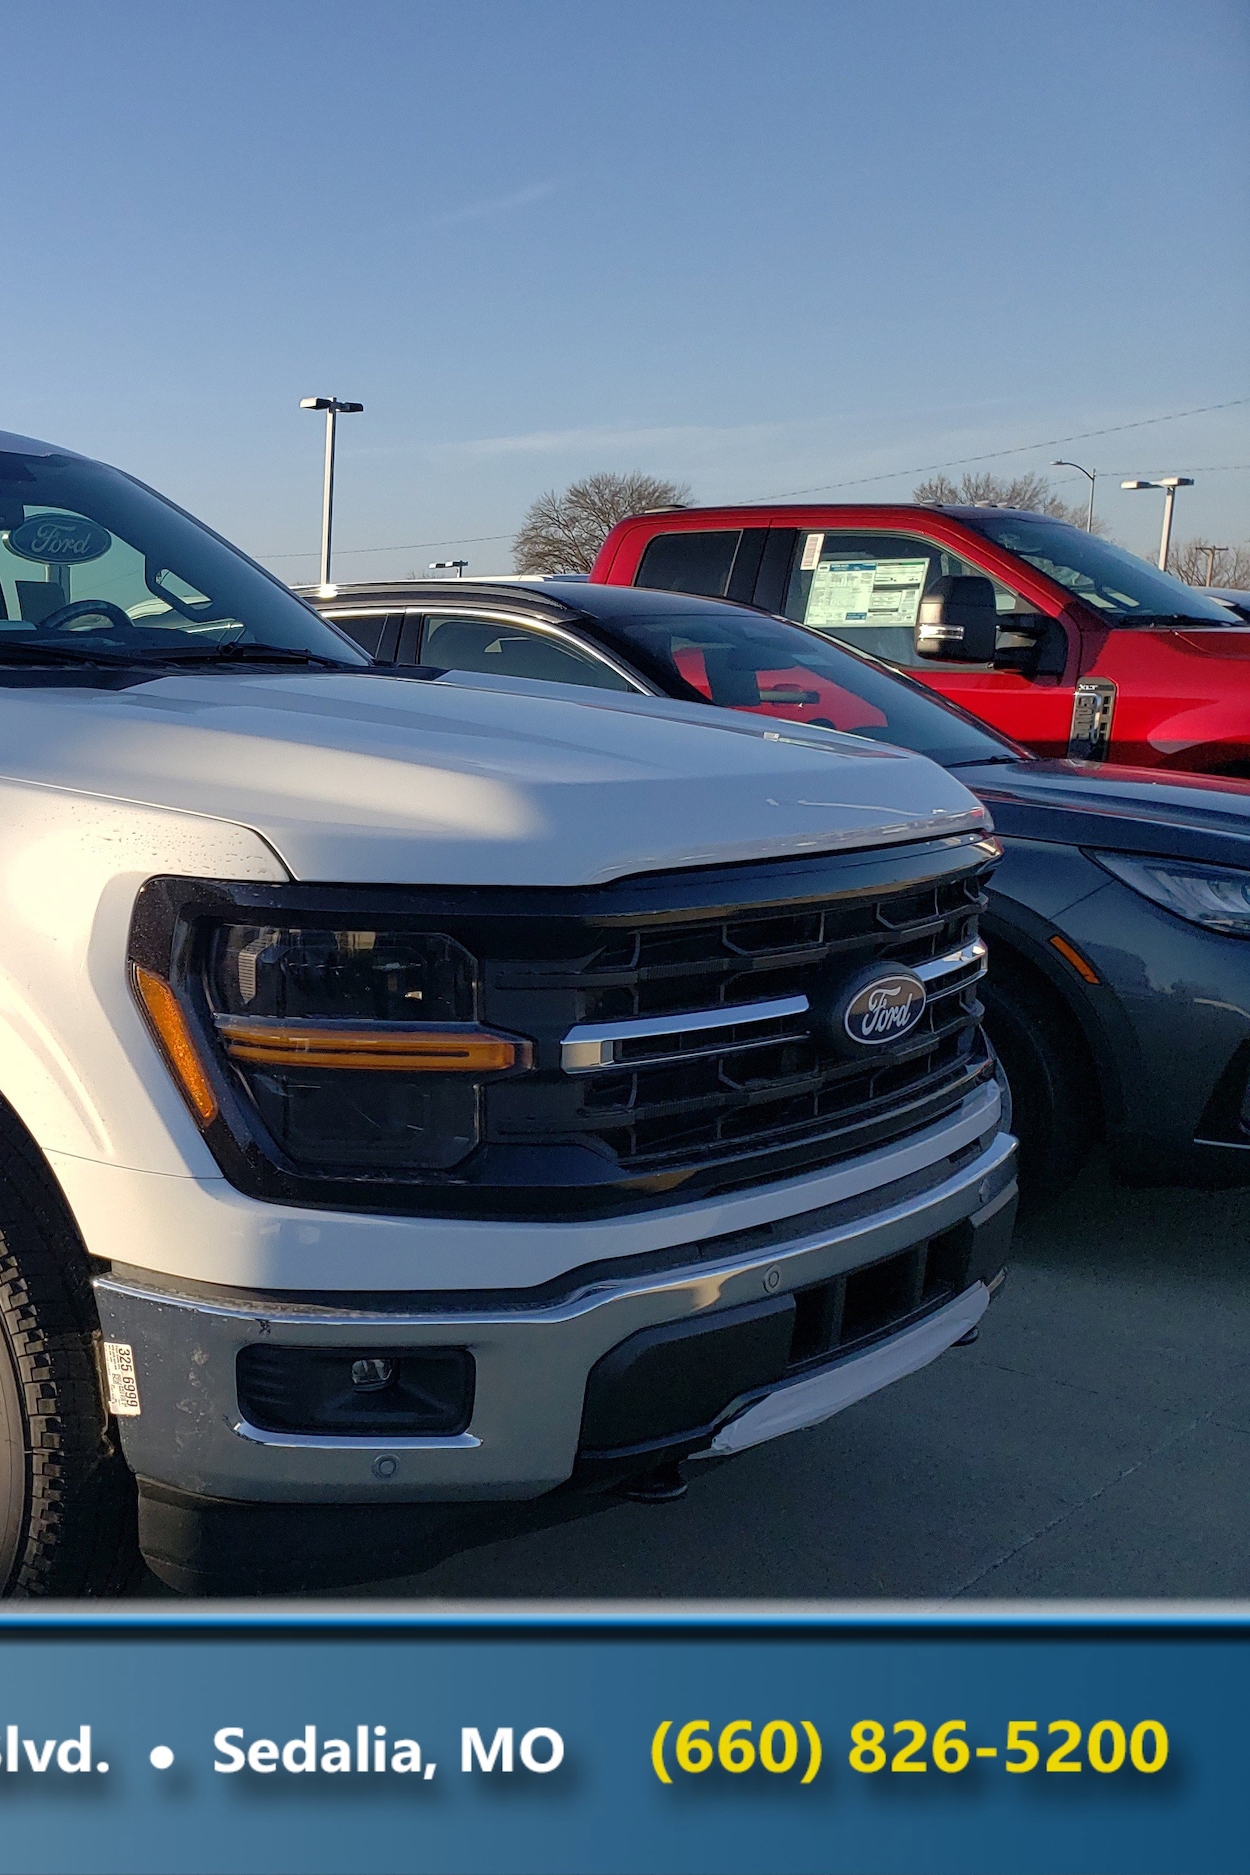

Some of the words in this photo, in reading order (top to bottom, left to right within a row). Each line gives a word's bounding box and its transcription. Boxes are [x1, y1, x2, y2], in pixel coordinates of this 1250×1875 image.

[31, 524, 91, 555] Ford
[861, 986, 913, 1036] Ford
[118, 1348, 133, 1372] 325
[122, 1376, 138, 1408] 6999
